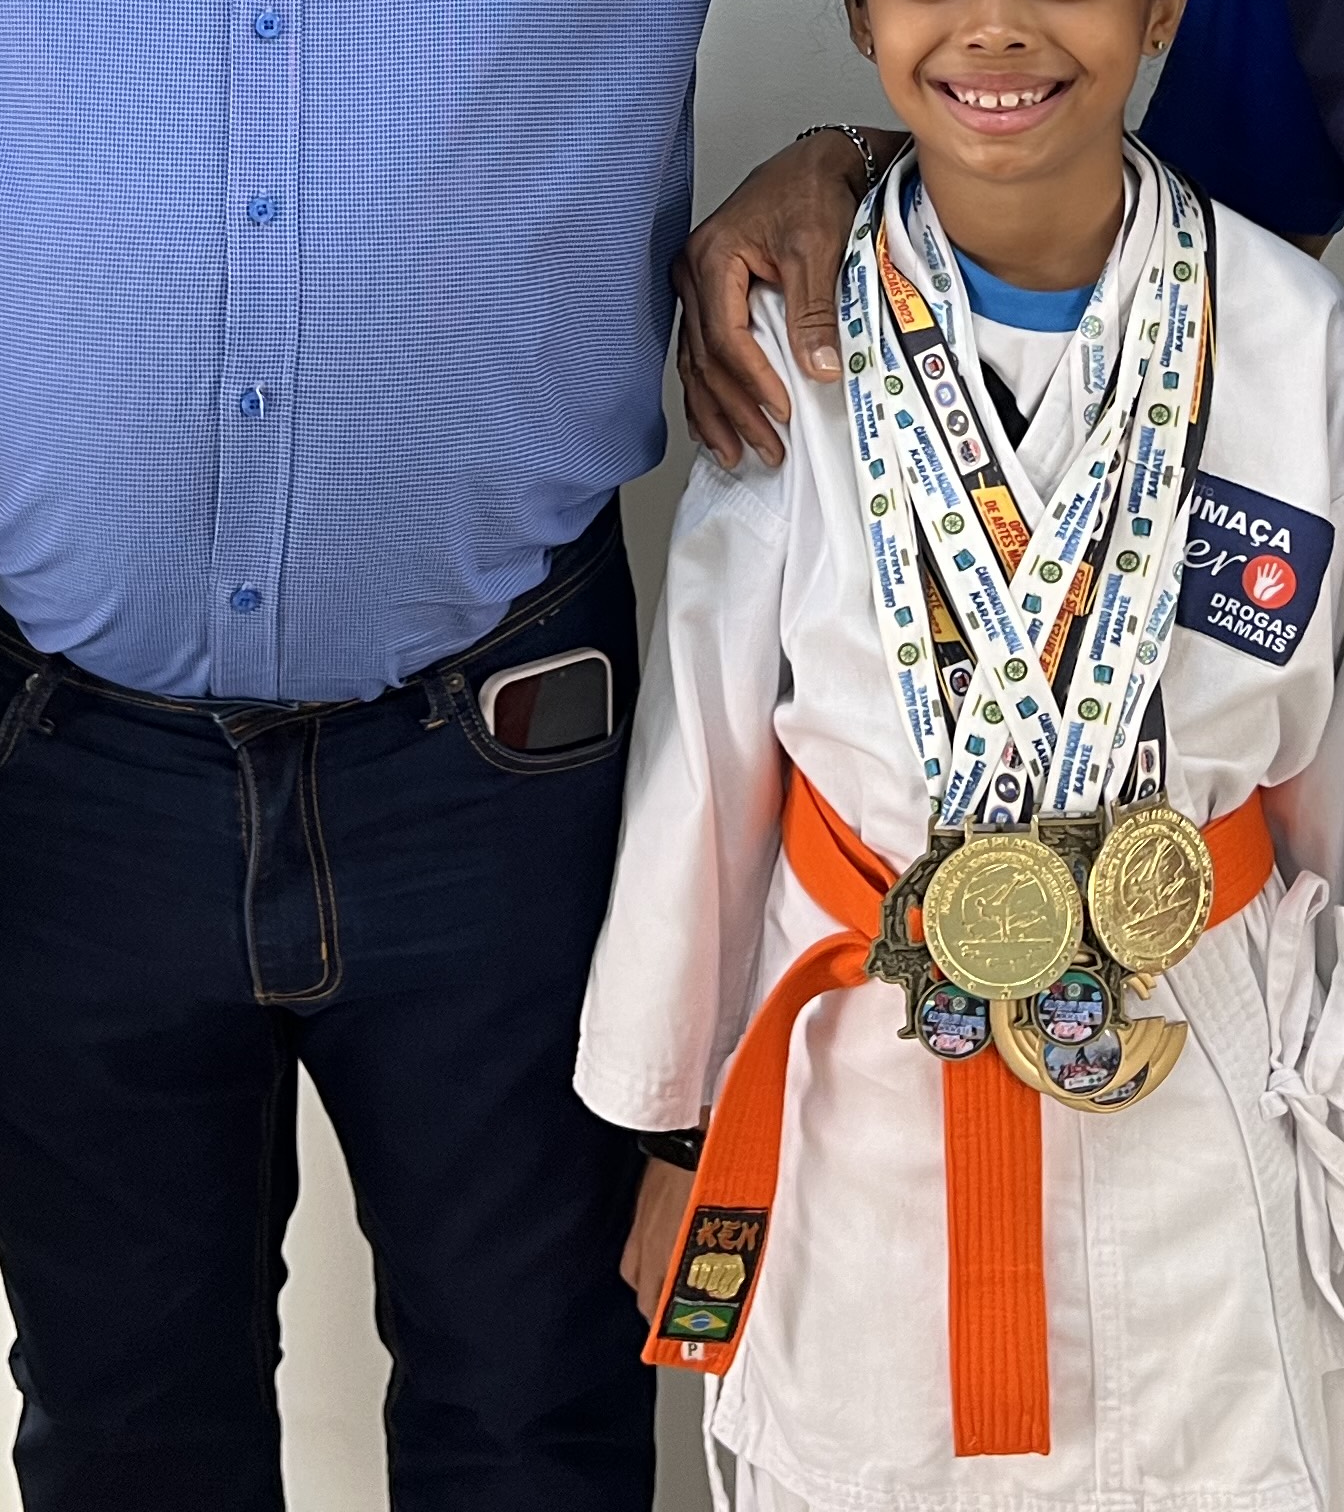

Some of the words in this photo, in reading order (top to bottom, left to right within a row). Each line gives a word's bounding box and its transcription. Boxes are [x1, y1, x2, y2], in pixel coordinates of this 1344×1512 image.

[893, 296, 915, 325] 2023
[984, 500, 1000, 515] DE
[991, 516, 1018, 554] ARTES
[1207, 610, 1288, 654] JAMAIS
[1210, 593, 1297, 640] DROGAS
